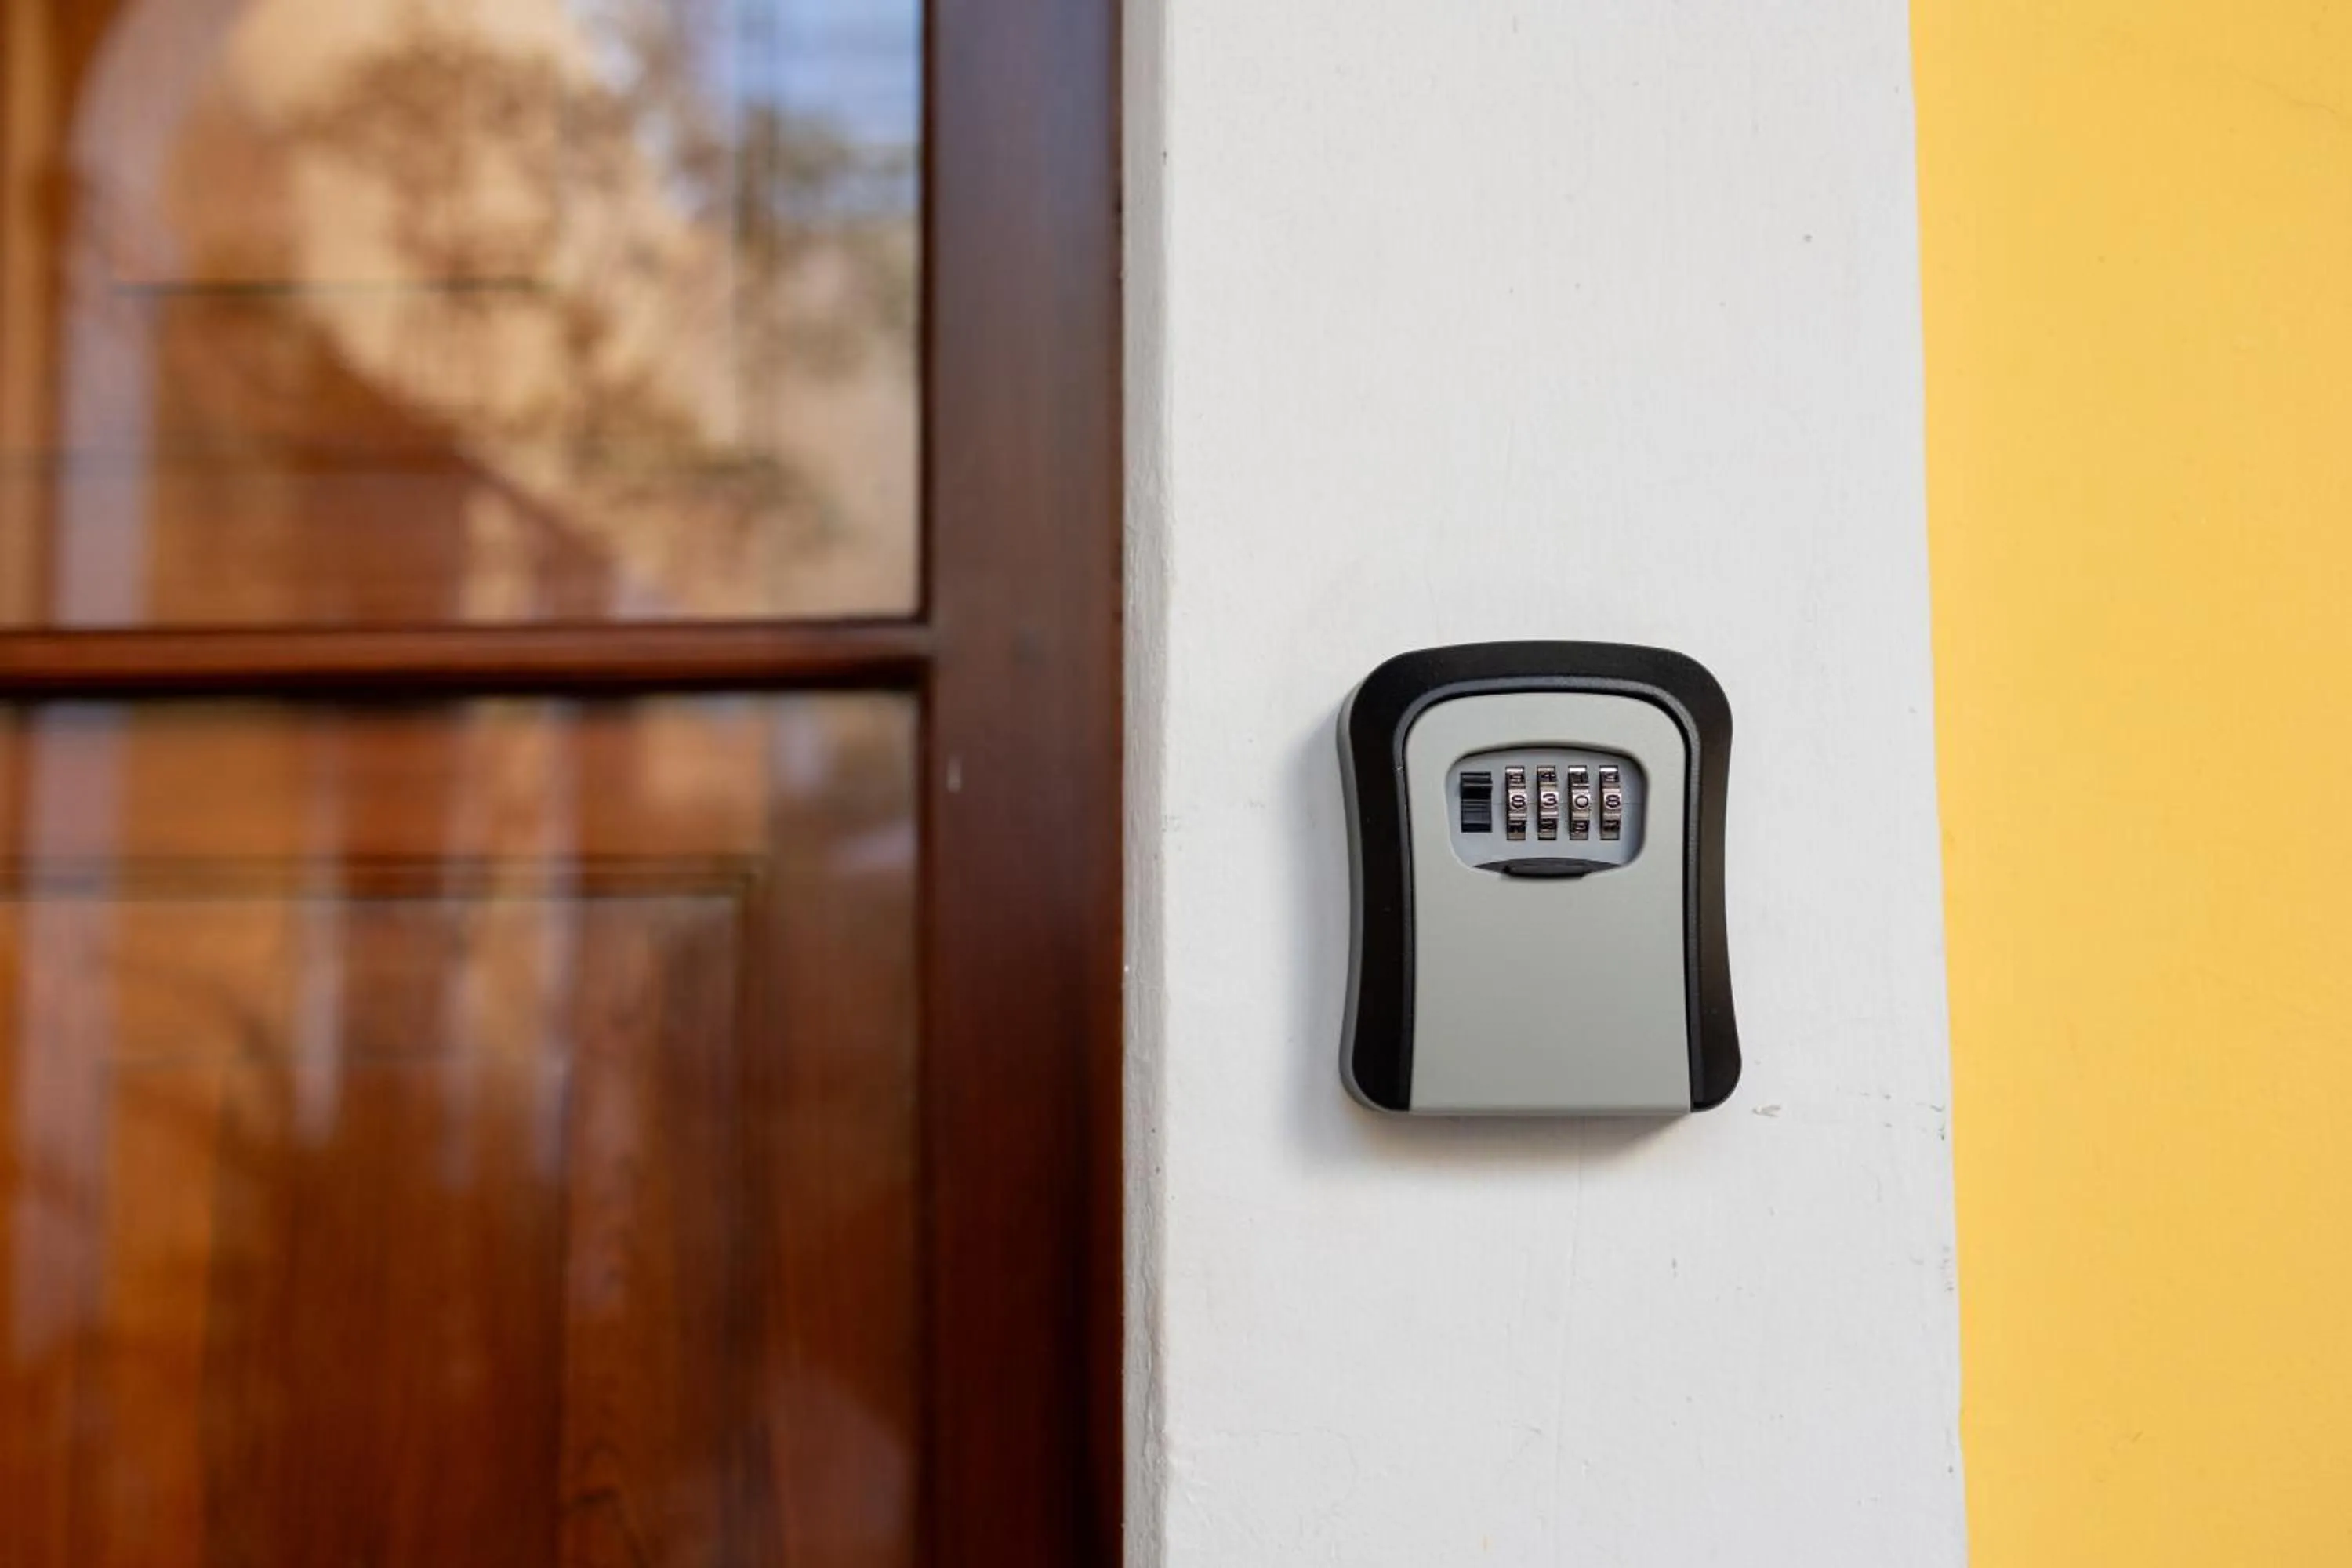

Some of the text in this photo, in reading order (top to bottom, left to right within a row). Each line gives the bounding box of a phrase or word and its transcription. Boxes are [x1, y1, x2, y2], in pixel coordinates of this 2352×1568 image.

[1511, 794, 1526, 808] 8
[1542, 793, 1558, 806] 3
[1605, 794, 1621, 808] 8
